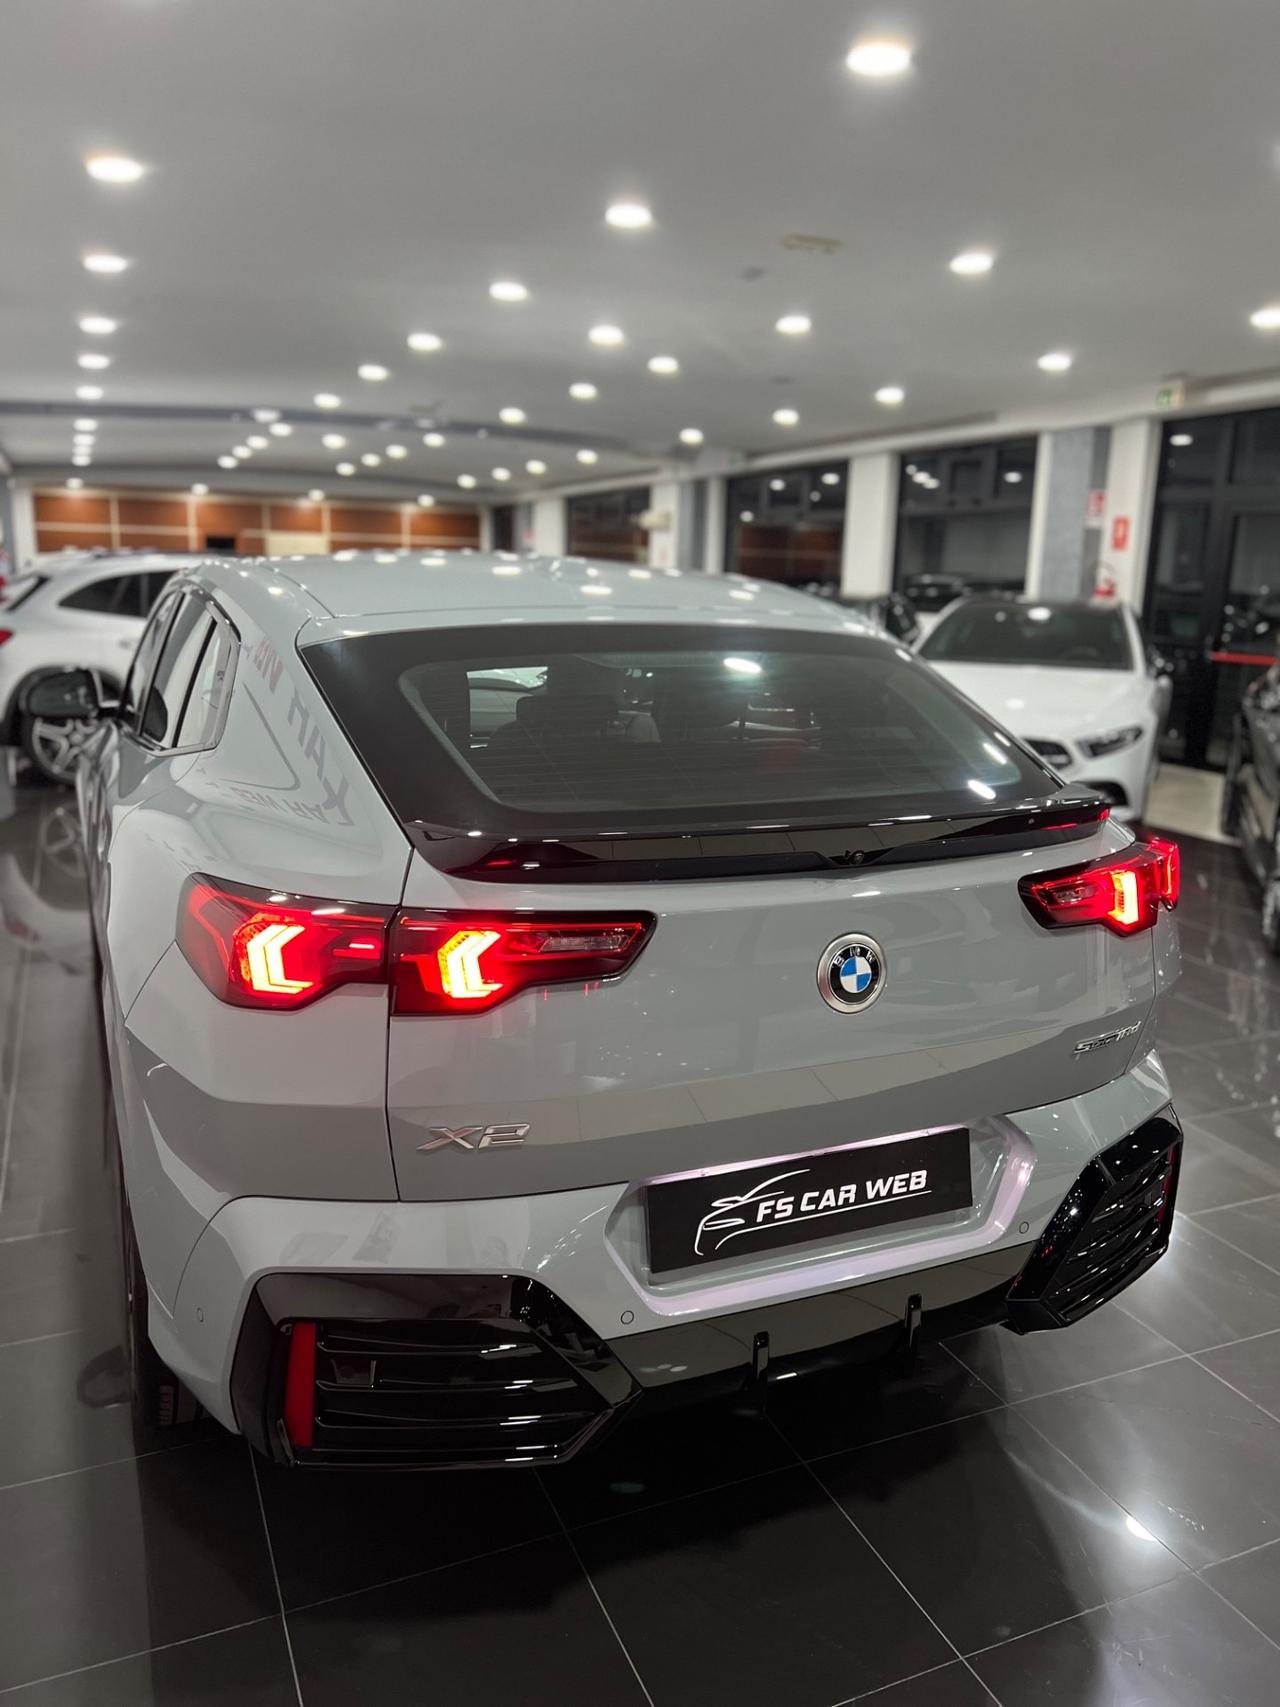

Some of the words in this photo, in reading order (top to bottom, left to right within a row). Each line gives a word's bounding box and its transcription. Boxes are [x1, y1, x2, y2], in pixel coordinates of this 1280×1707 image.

[416, 1123, 531, 1149] X2
[756, 1196, 795, 1223] FS
[800, 1184, 857, 1212] CAR
[865, 1170, 928, 1200] WEB
